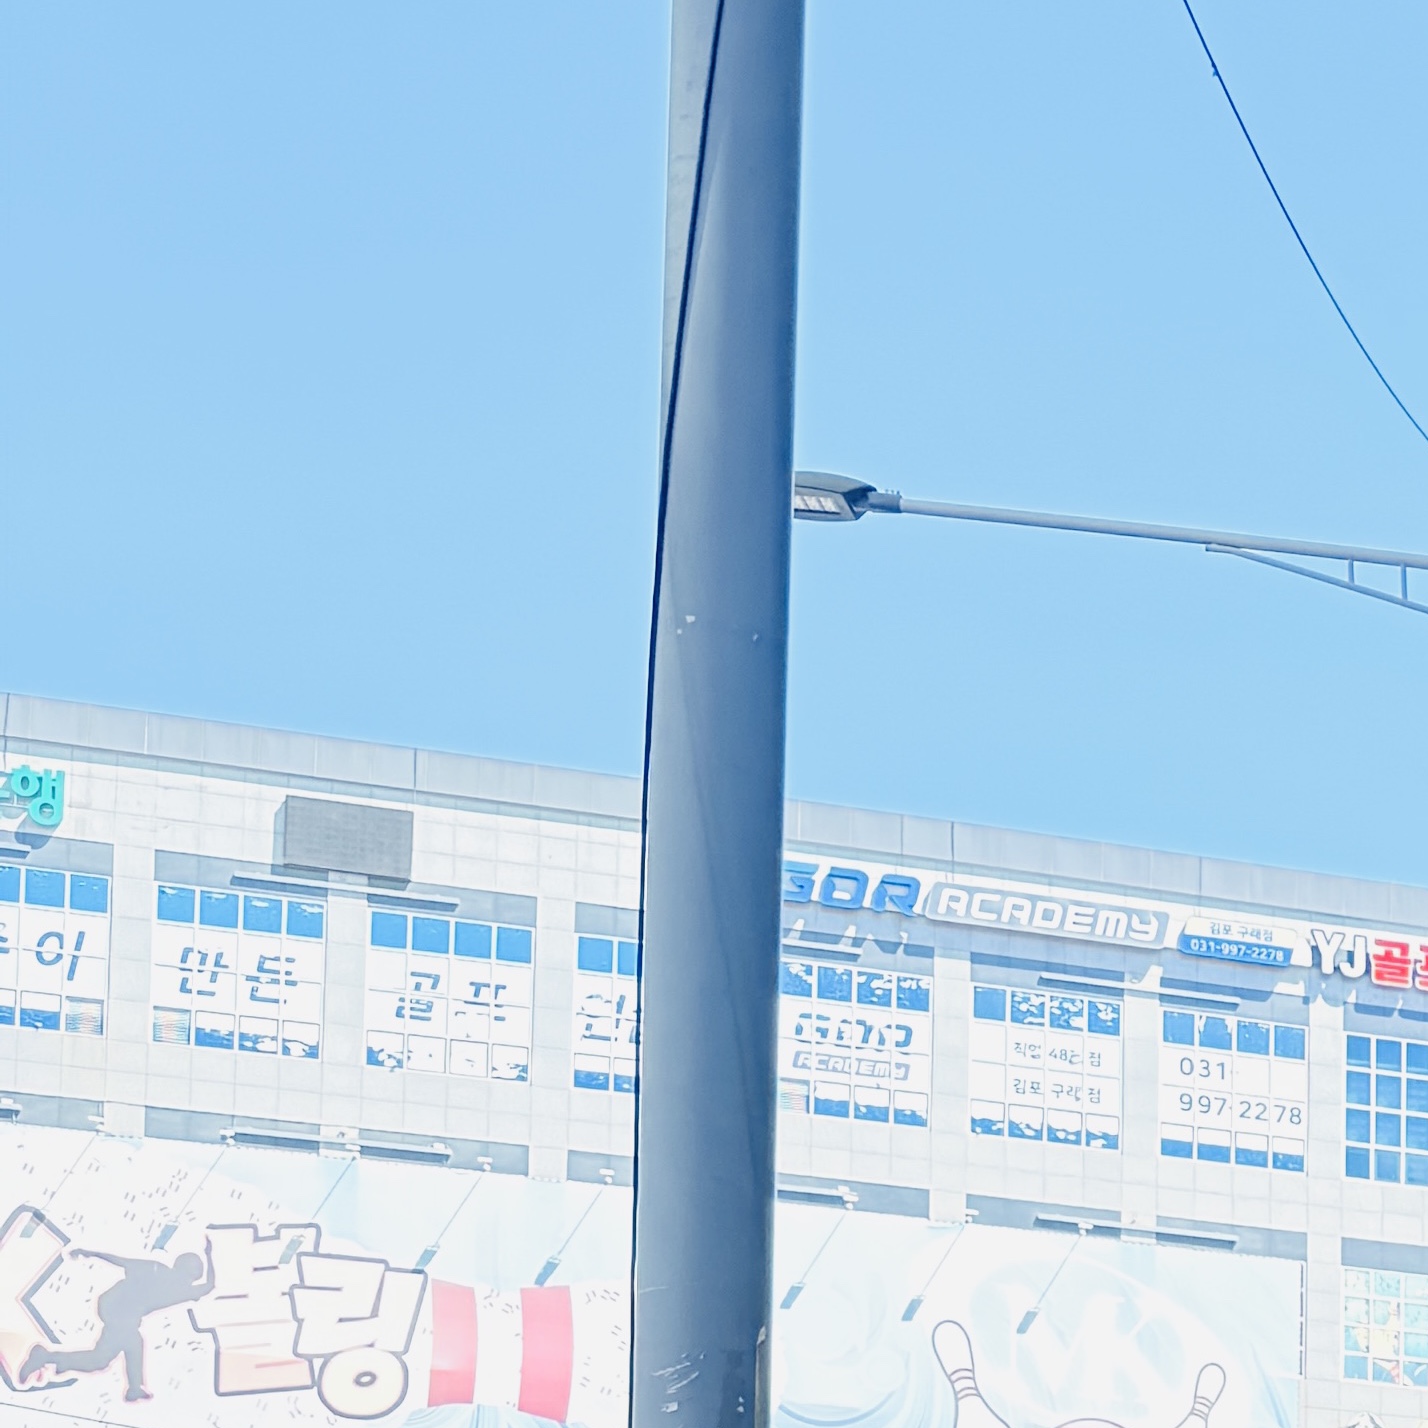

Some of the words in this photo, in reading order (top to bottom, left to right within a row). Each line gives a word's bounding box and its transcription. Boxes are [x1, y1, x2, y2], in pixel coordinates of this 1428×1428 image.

[0, 764, 66, 826] 행
[936, 888, 1161, 943] ACADEMY
[0, 923, 86, 984] 이
